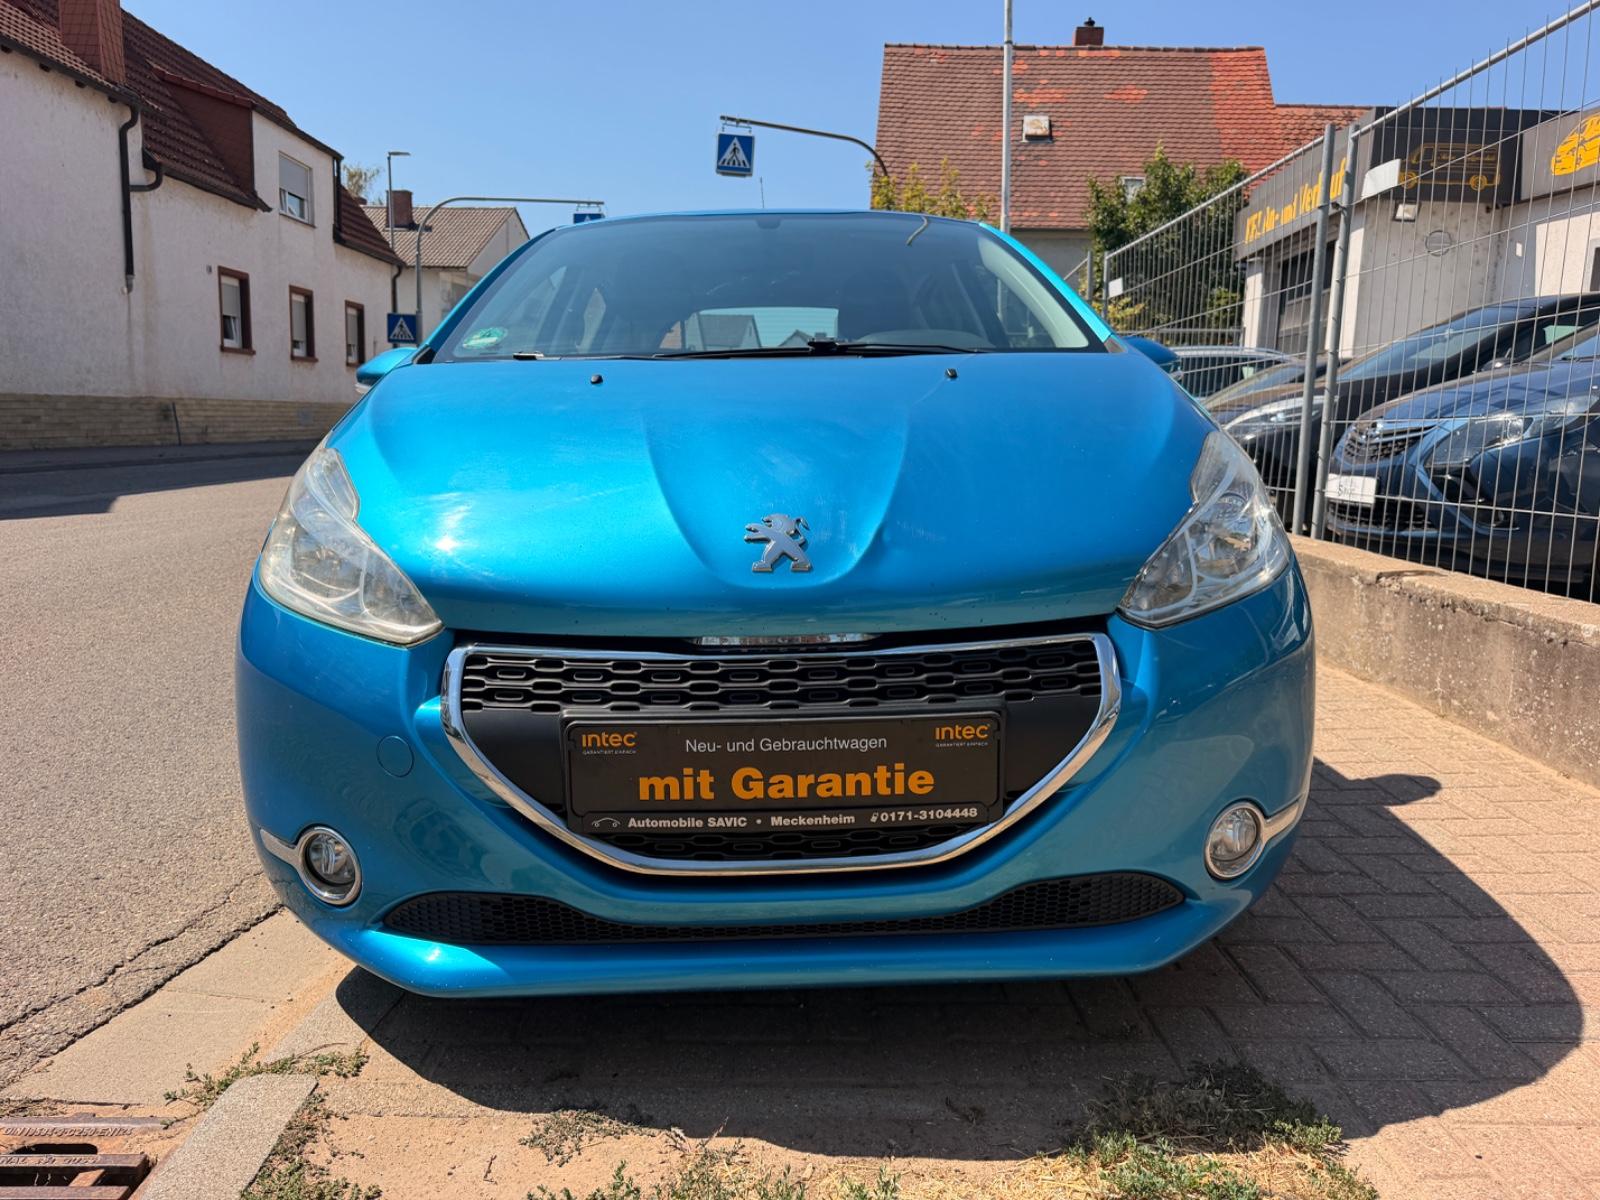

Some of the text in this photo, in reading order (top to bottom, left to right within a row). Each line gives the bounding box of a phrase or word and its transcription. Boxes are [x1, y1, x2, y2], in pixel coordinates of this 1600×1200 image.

[1301, 157, 1346, 215] Veruf
[582, 732, 637, 747] intec
[935, 724, 989, 740] intec
[686, 736, 887, 752] Neu- und Gebrauchtwagen
[639, 763, 935, 800] mit Garantie
[628, 807, 978, 828] Automobile SAVIC Meckenheim 0171-3104448
